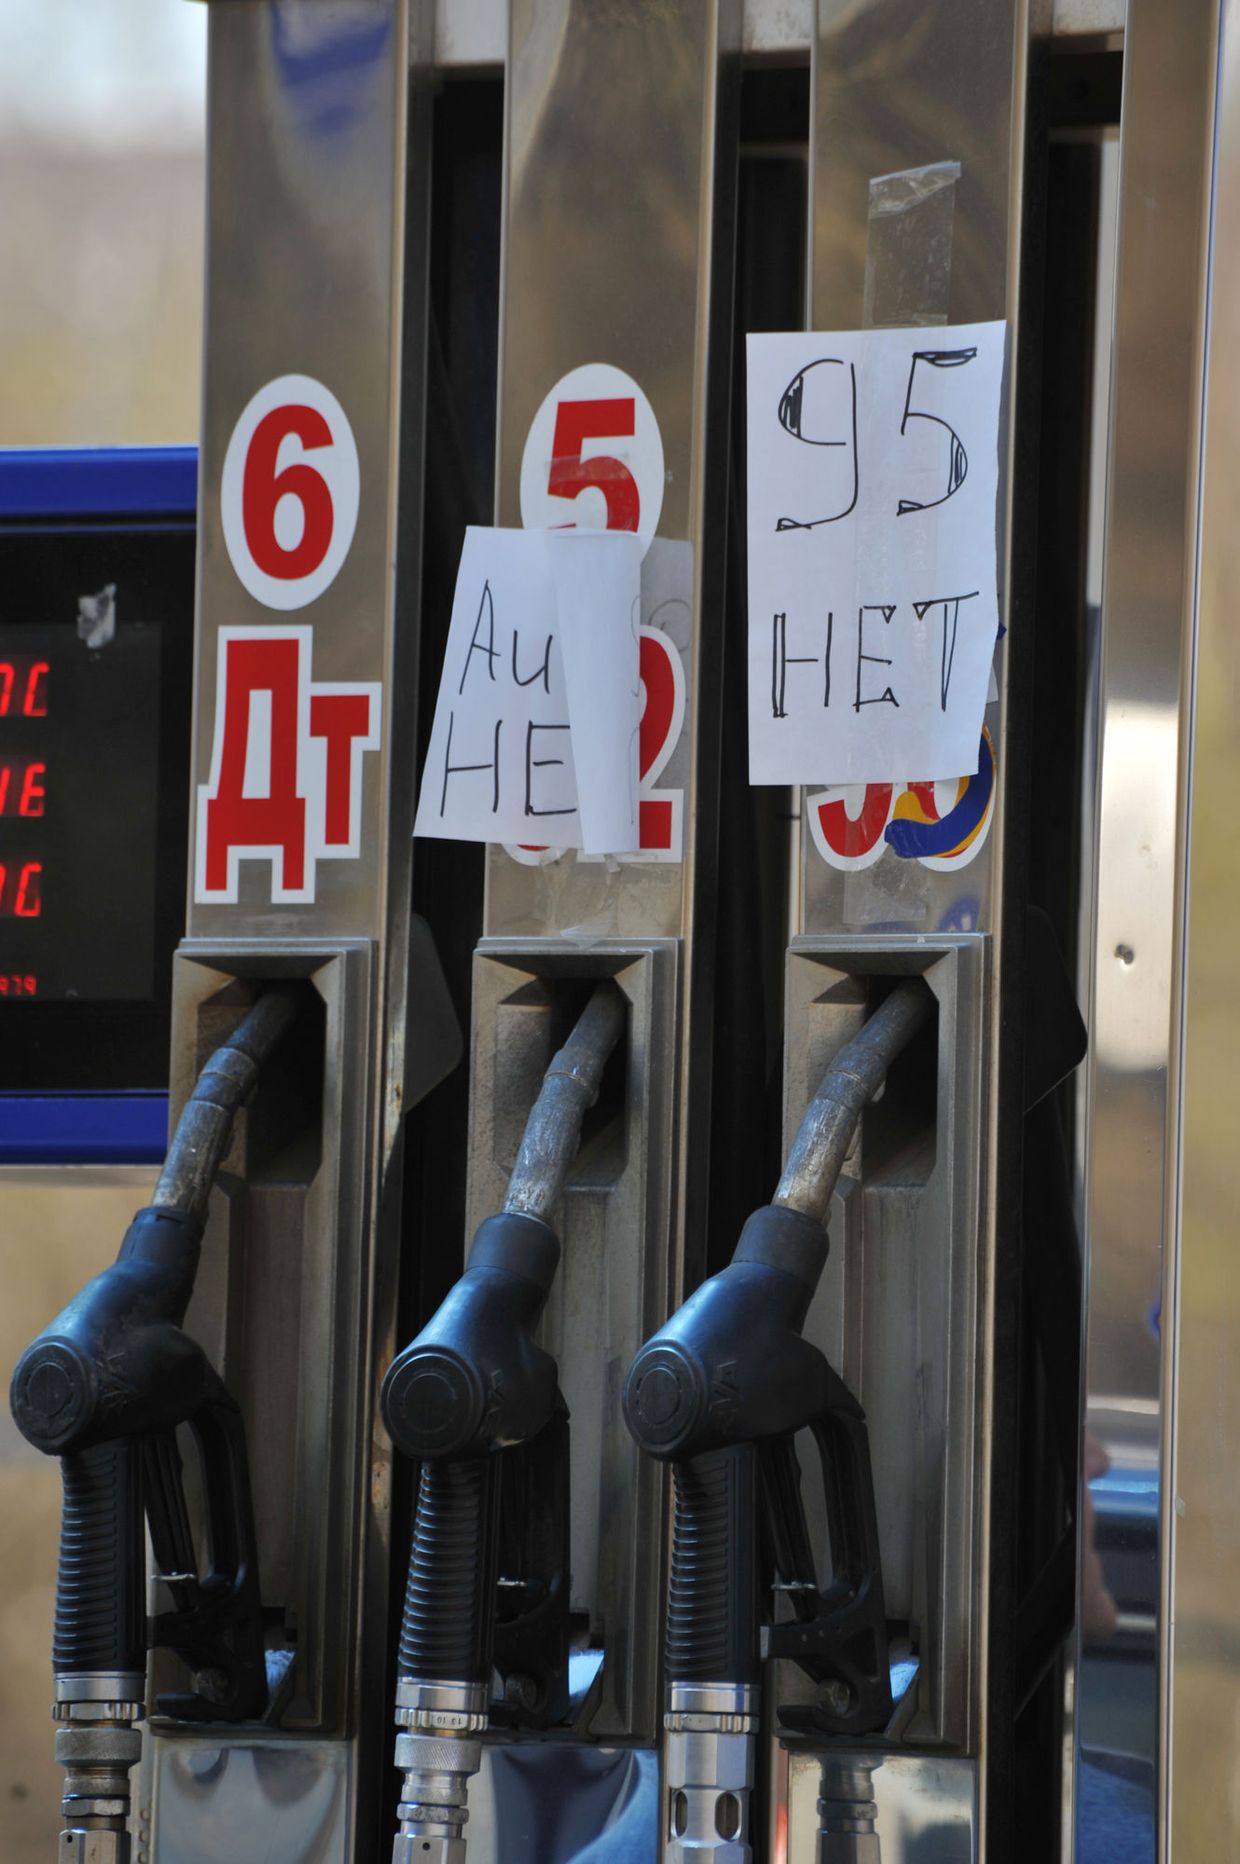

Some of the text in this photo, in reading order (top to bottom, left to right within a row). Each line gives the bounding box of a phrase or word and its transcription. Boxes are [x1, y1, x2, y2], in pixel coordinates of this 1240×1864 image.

[242, 403, 334, 580] 6
[547, 397, 641, 532] 5
[775, 346, 978, 532] 95
[772, 591, 979, 718] НЕТ
